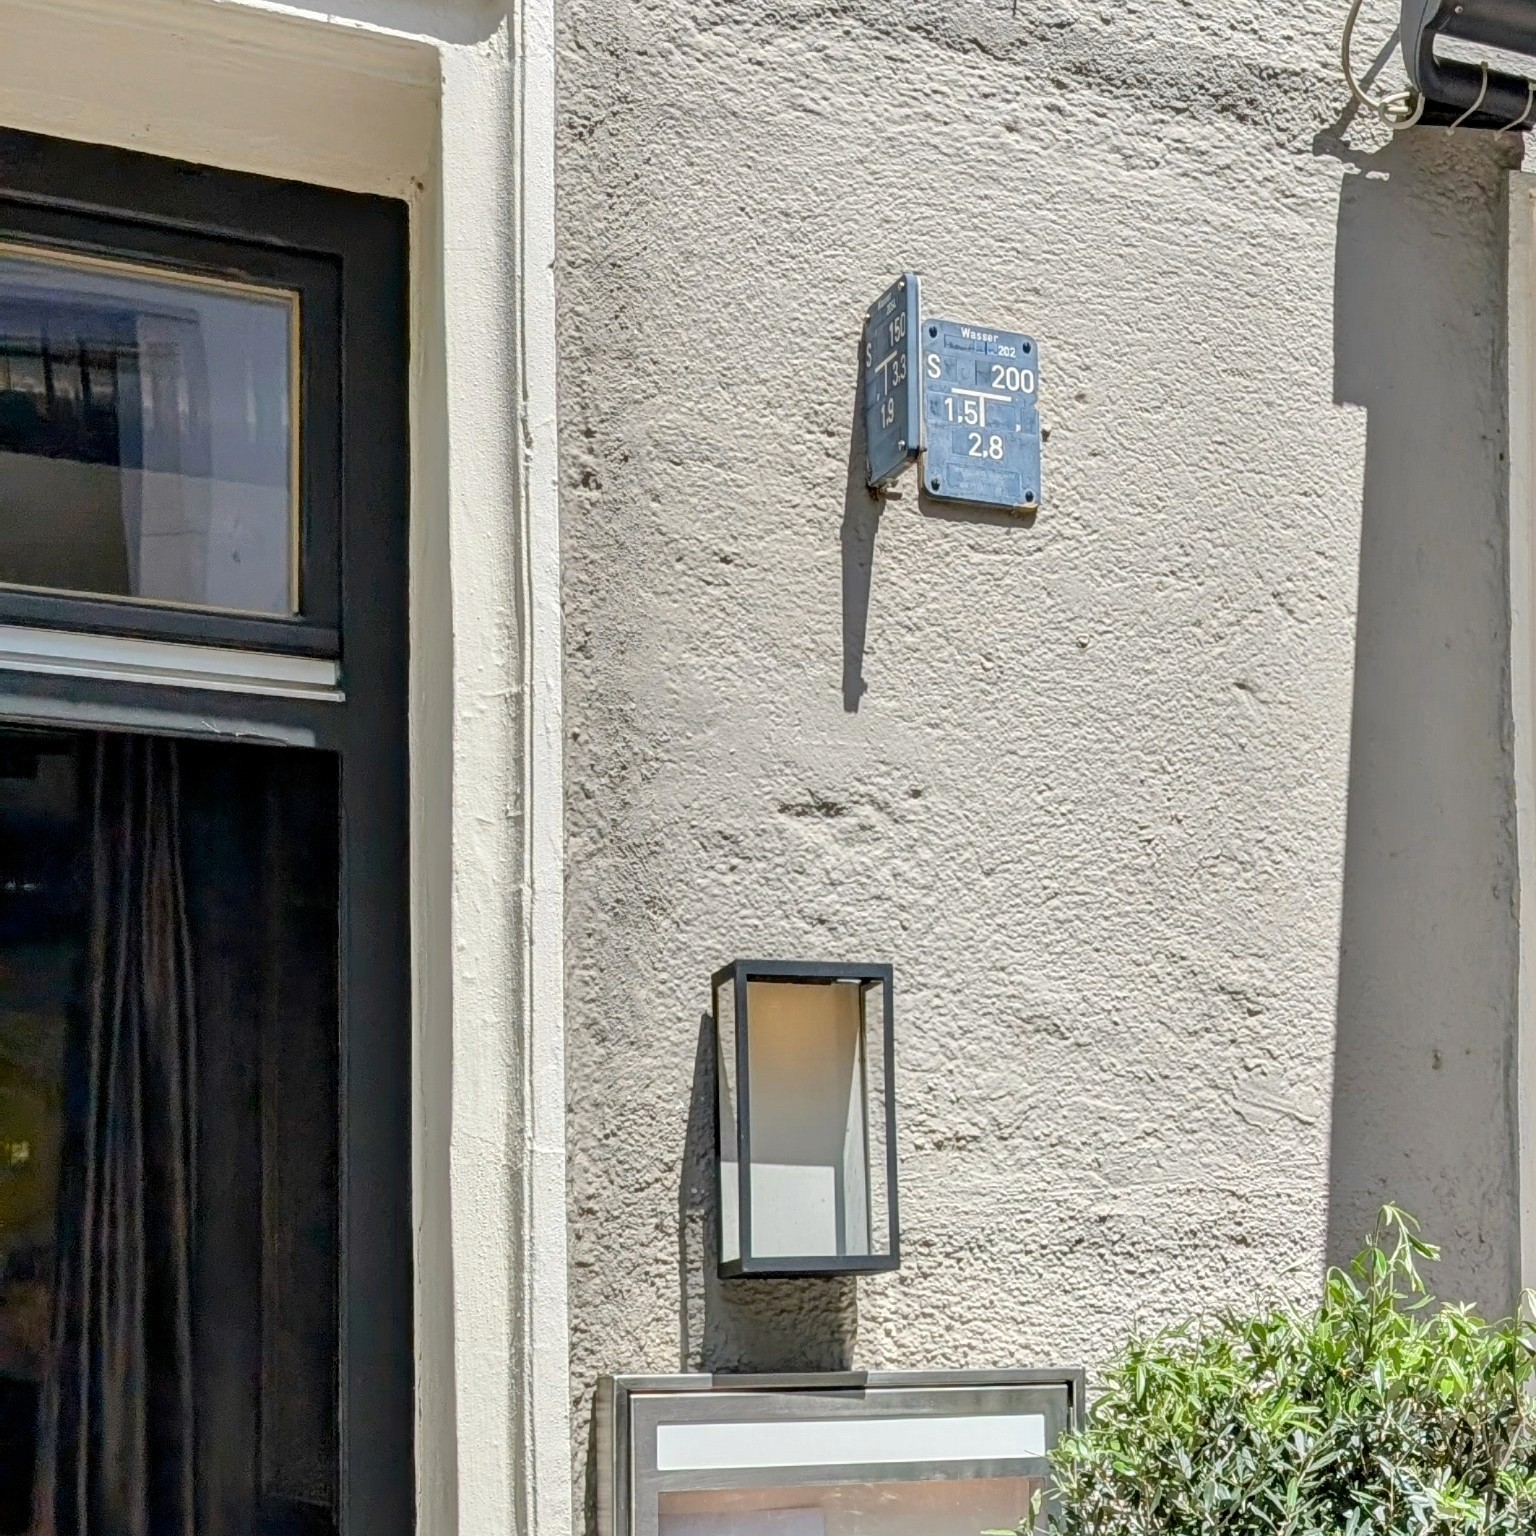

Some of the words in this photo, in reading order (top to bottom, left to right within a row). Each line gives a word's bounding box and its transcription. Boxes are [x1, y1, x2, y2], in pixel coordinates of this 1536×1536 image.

[866, 343, 873, 368] S
[888, 311, 906, 347] 150
[960, 327, 999, 343] Wasser
[998, 345, 1017, 358] 202
[927, 354, 941, 379] S
[991, 365, 1035, 393] 200
[880, 397, 895, 429] 1,9
[944, 397, 978, 425] 1,5
[968, 432, 1004, 460] 2,8
